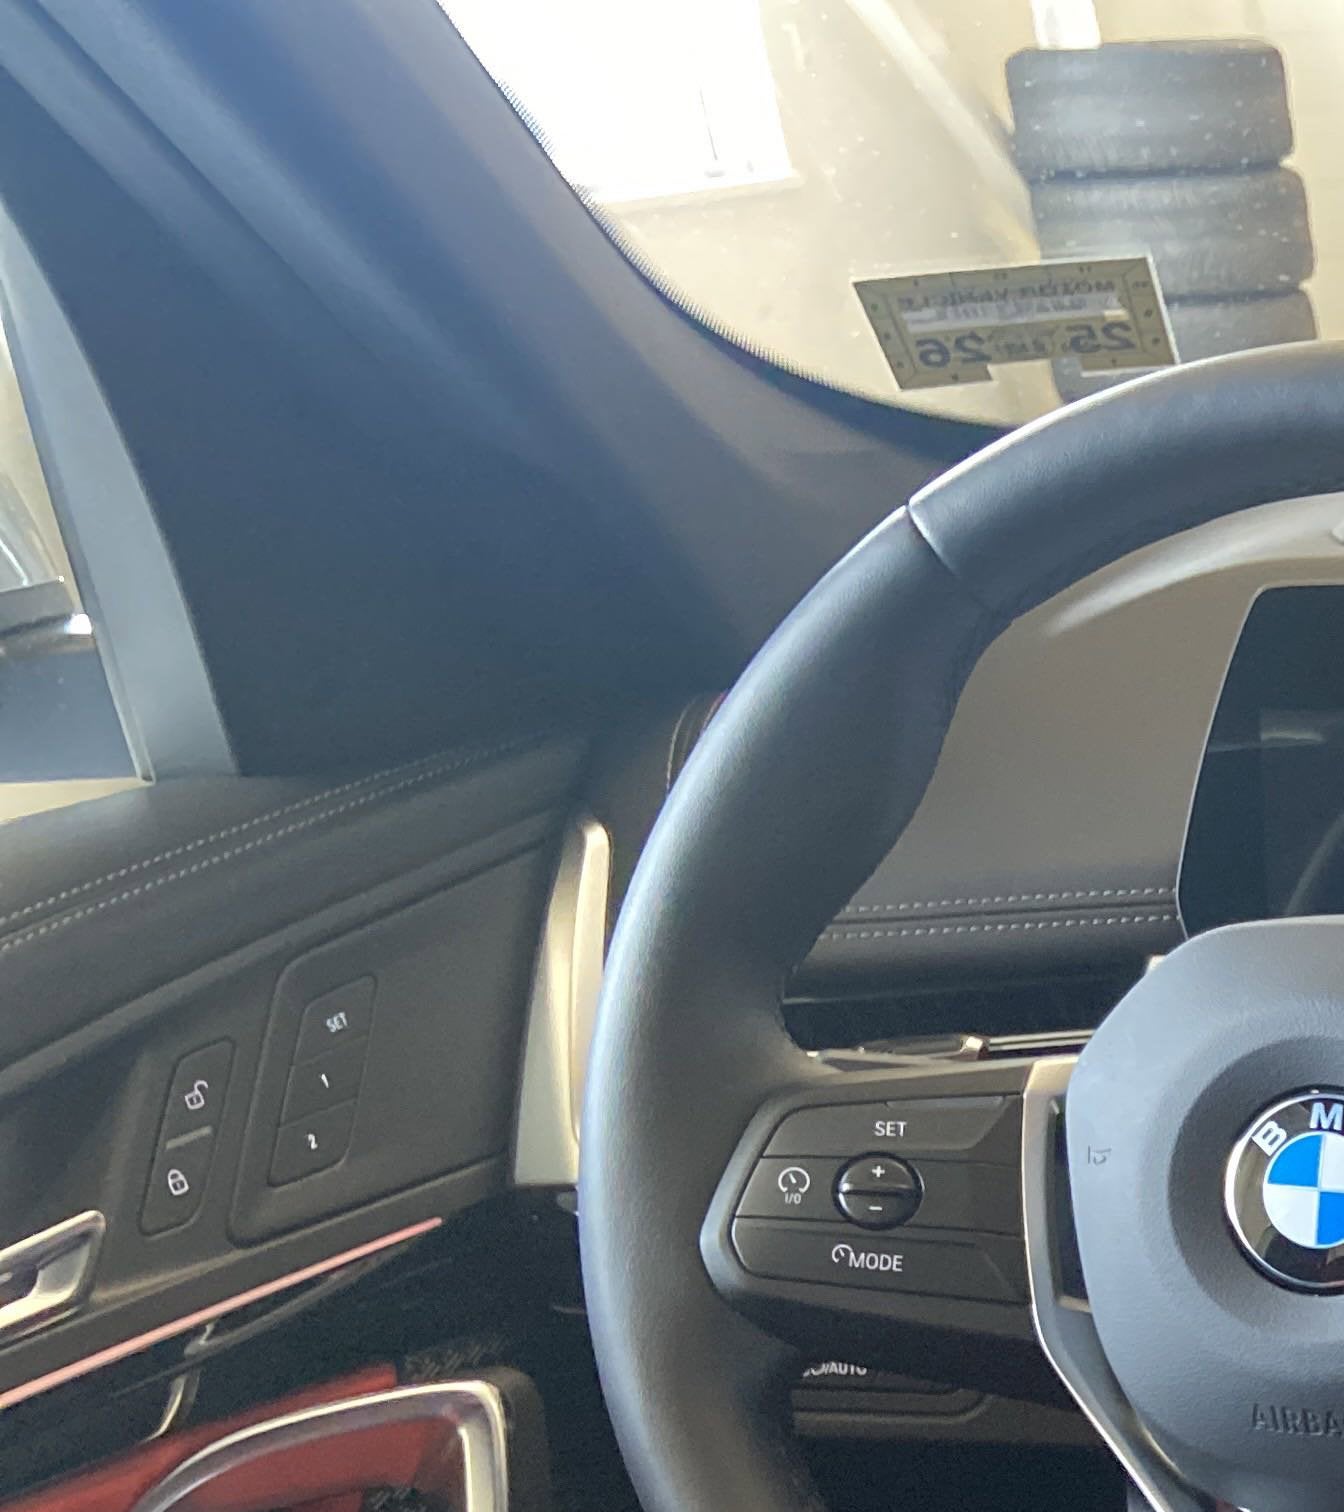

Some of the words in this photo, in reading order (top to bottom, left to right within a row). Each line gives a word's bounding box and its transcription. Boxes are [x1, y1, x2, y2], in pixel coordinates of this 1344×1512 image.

[874, 1121, 907, 1137] SET
[306, 1133, 318, 1150] 2
[849, 1252, 904, 1272] MODE
